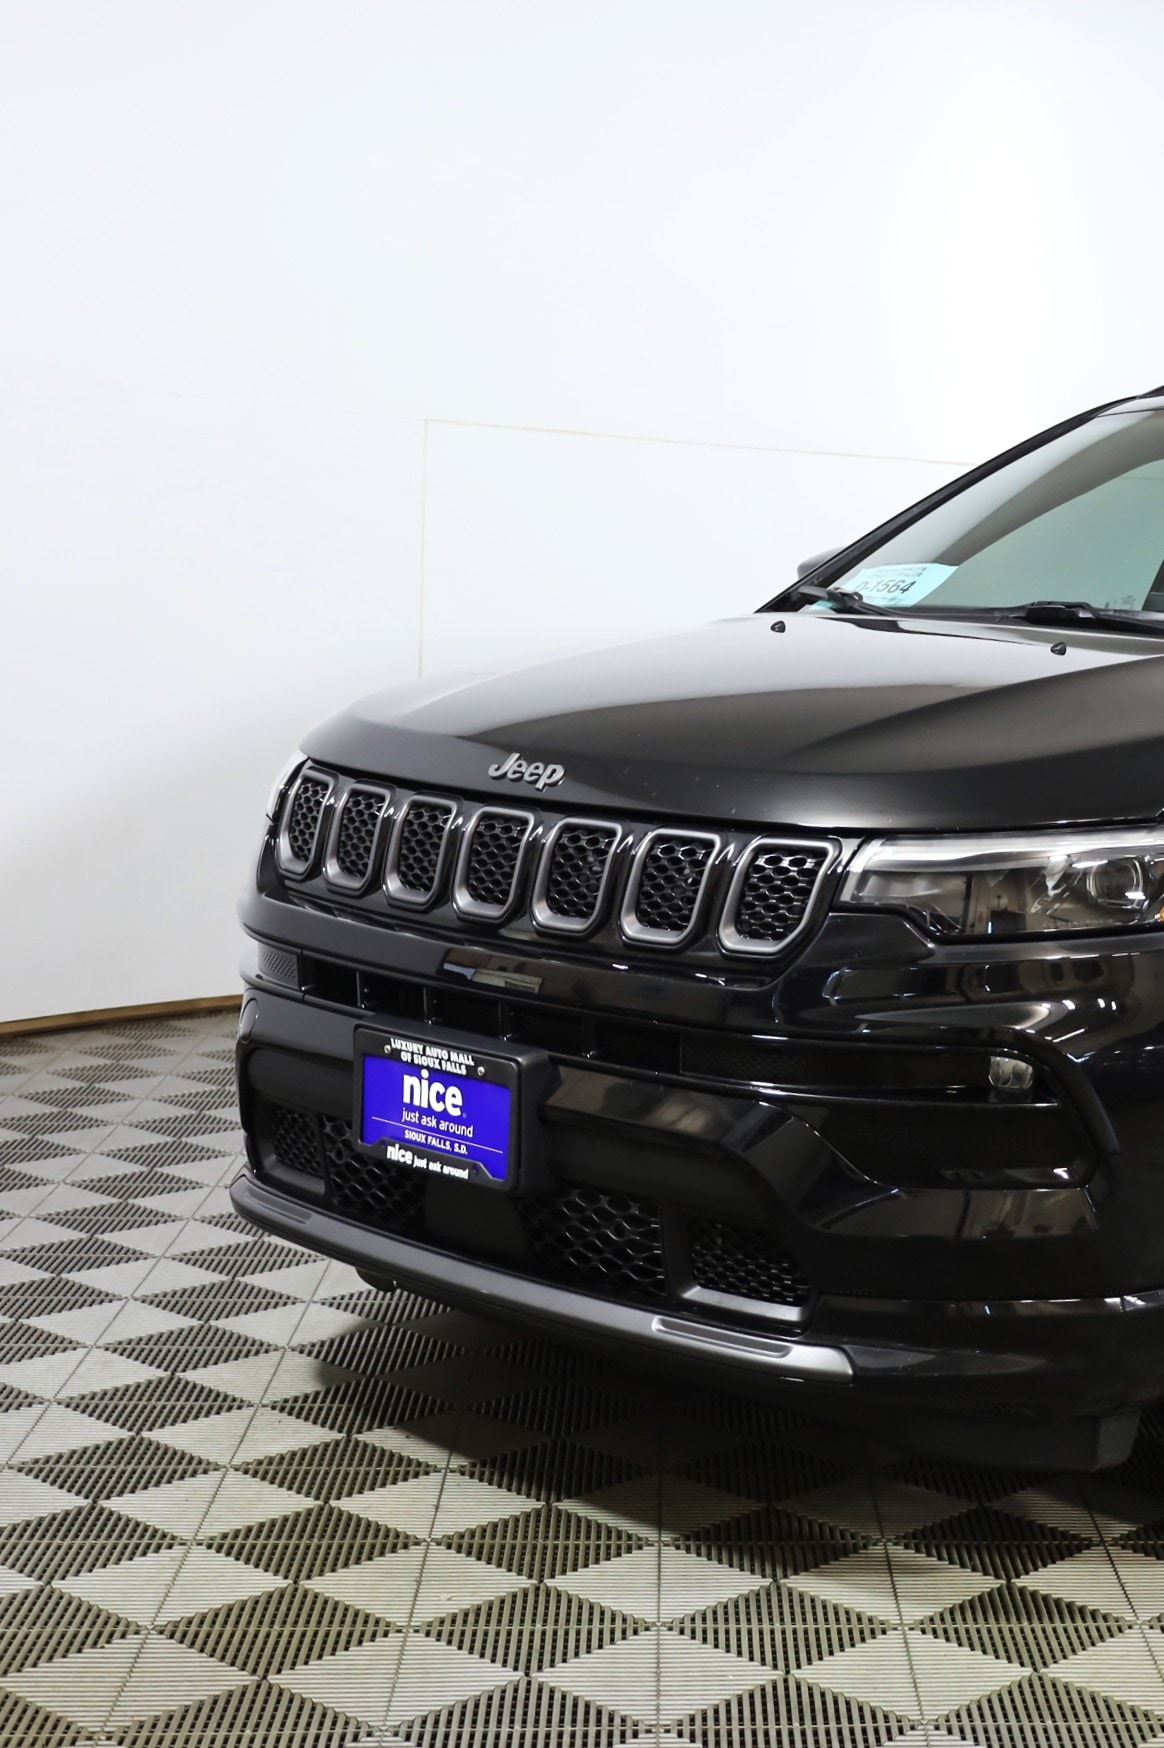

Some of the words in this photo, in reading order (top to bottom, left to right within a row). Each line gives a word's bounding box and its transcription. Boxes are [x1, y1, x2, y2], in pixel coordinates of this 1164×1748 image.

[488, 752, 565, 791] Jeep
[390, 1037, 424, 1055] LUXURY
[425, 1046, 449, 1060] AUTO
[450, 1051, 475, 1066] MALL
[400, 1051, 412, 1063] OF
[413, 1053, 441, 1070] SIOUX
[441, 1060, 467, 1076] FALLS
[403, 1068, 463, 1117] nice
[402, 1107, 420, 1124] just
[420, 1115, 437, 1128] ask
[439, 1120, 474, 1138] around
[404, 1129, 426, 1144] SIOUX
[427, 1135, 452, 1152] FALLS,
[453, 1143, 468, 1155] S.D.
[386, 1143, 413, 1165] nice
[412, 1155, 428, 1168] just
[428, 1161, 442, 1173] ask
[442, 1165, 469, 1180] around
